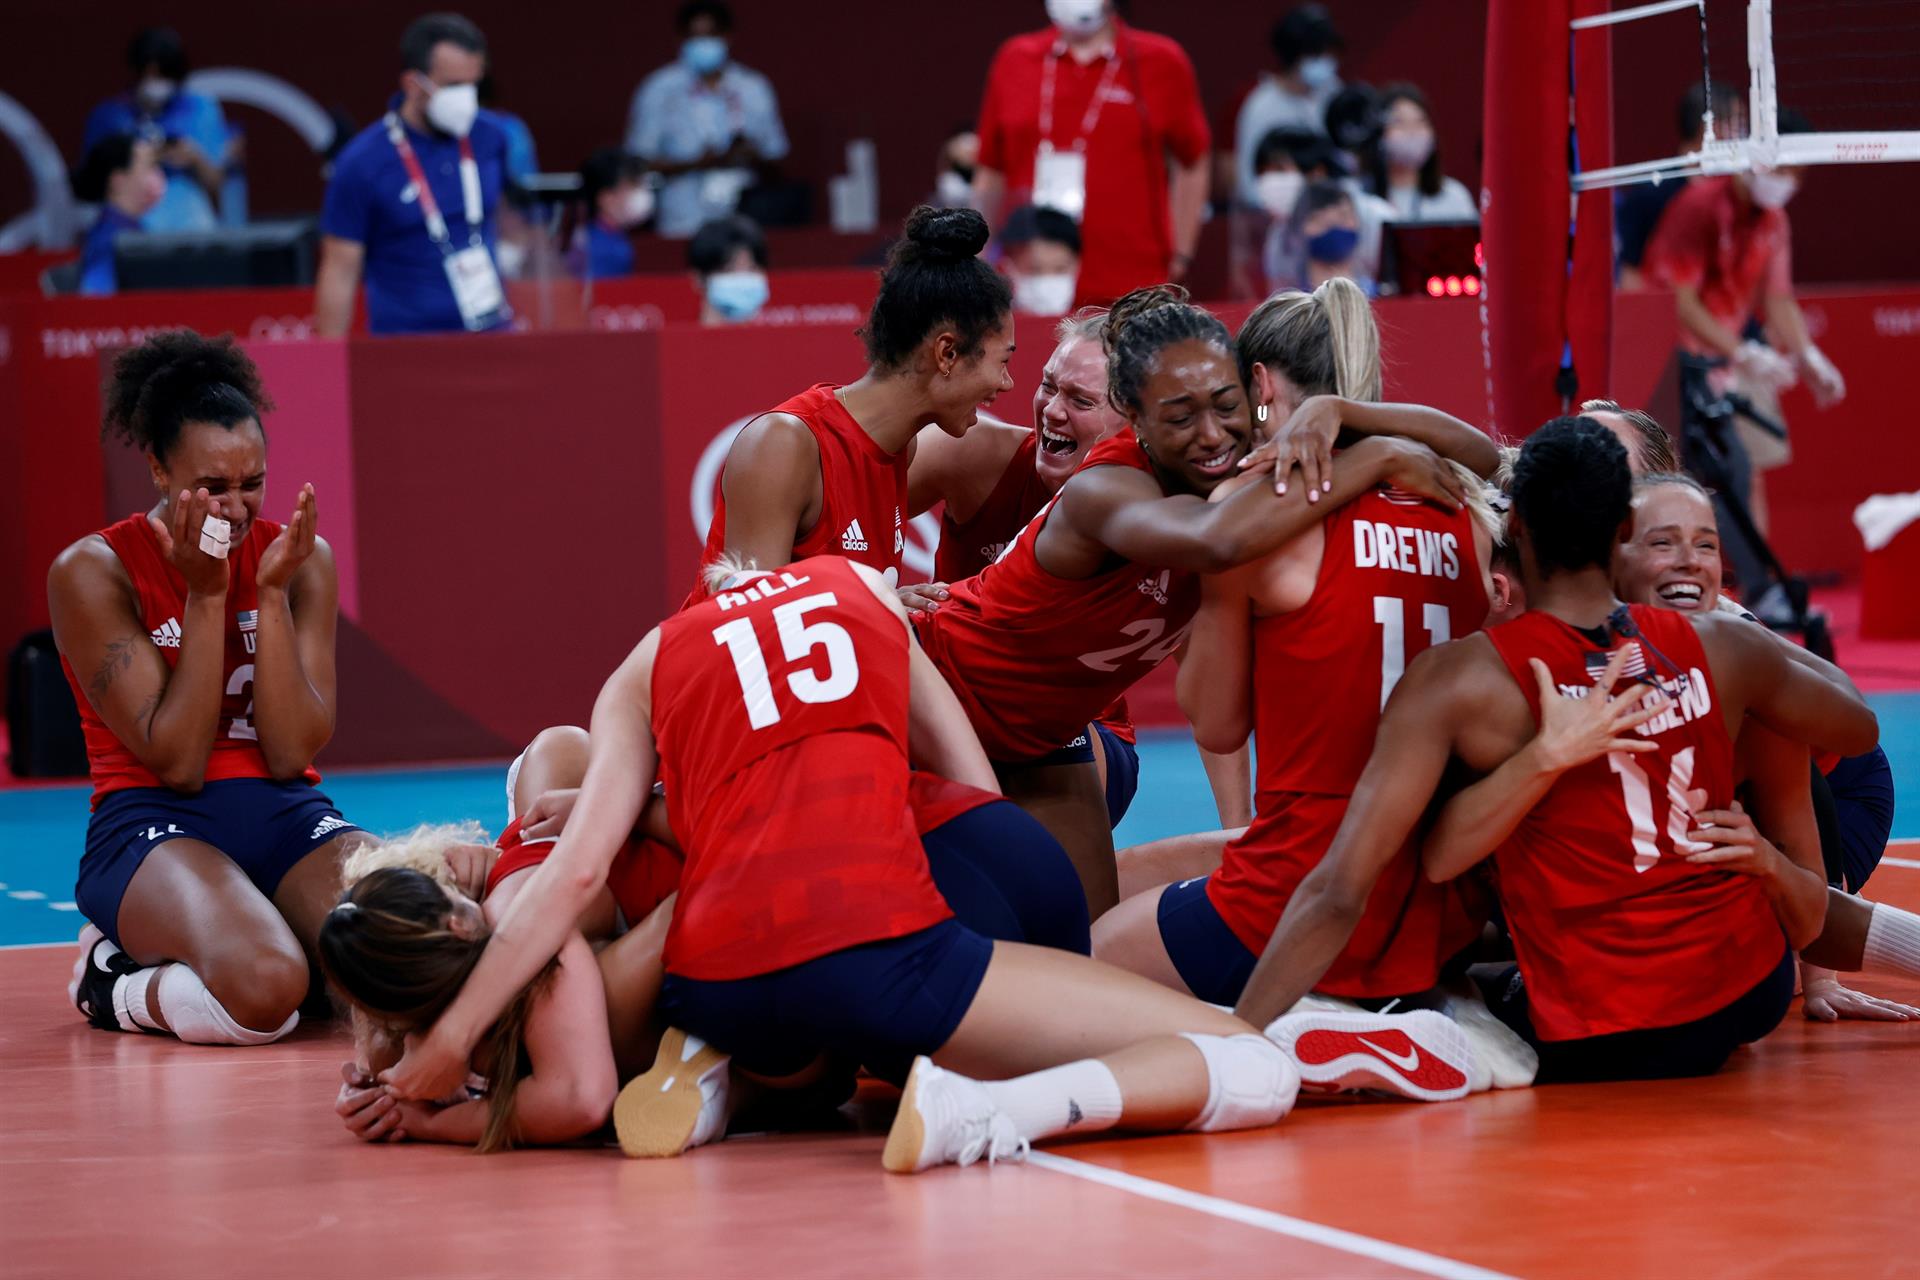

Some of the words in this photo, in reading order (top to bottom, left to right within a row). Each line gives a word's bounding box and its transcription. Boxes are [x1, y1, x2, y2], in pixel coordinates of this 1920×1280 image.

[1353, 519, 1459, 581] DREWS
[716, 572, 811, 611] HILL
[712, 591, 860, 731] 15
